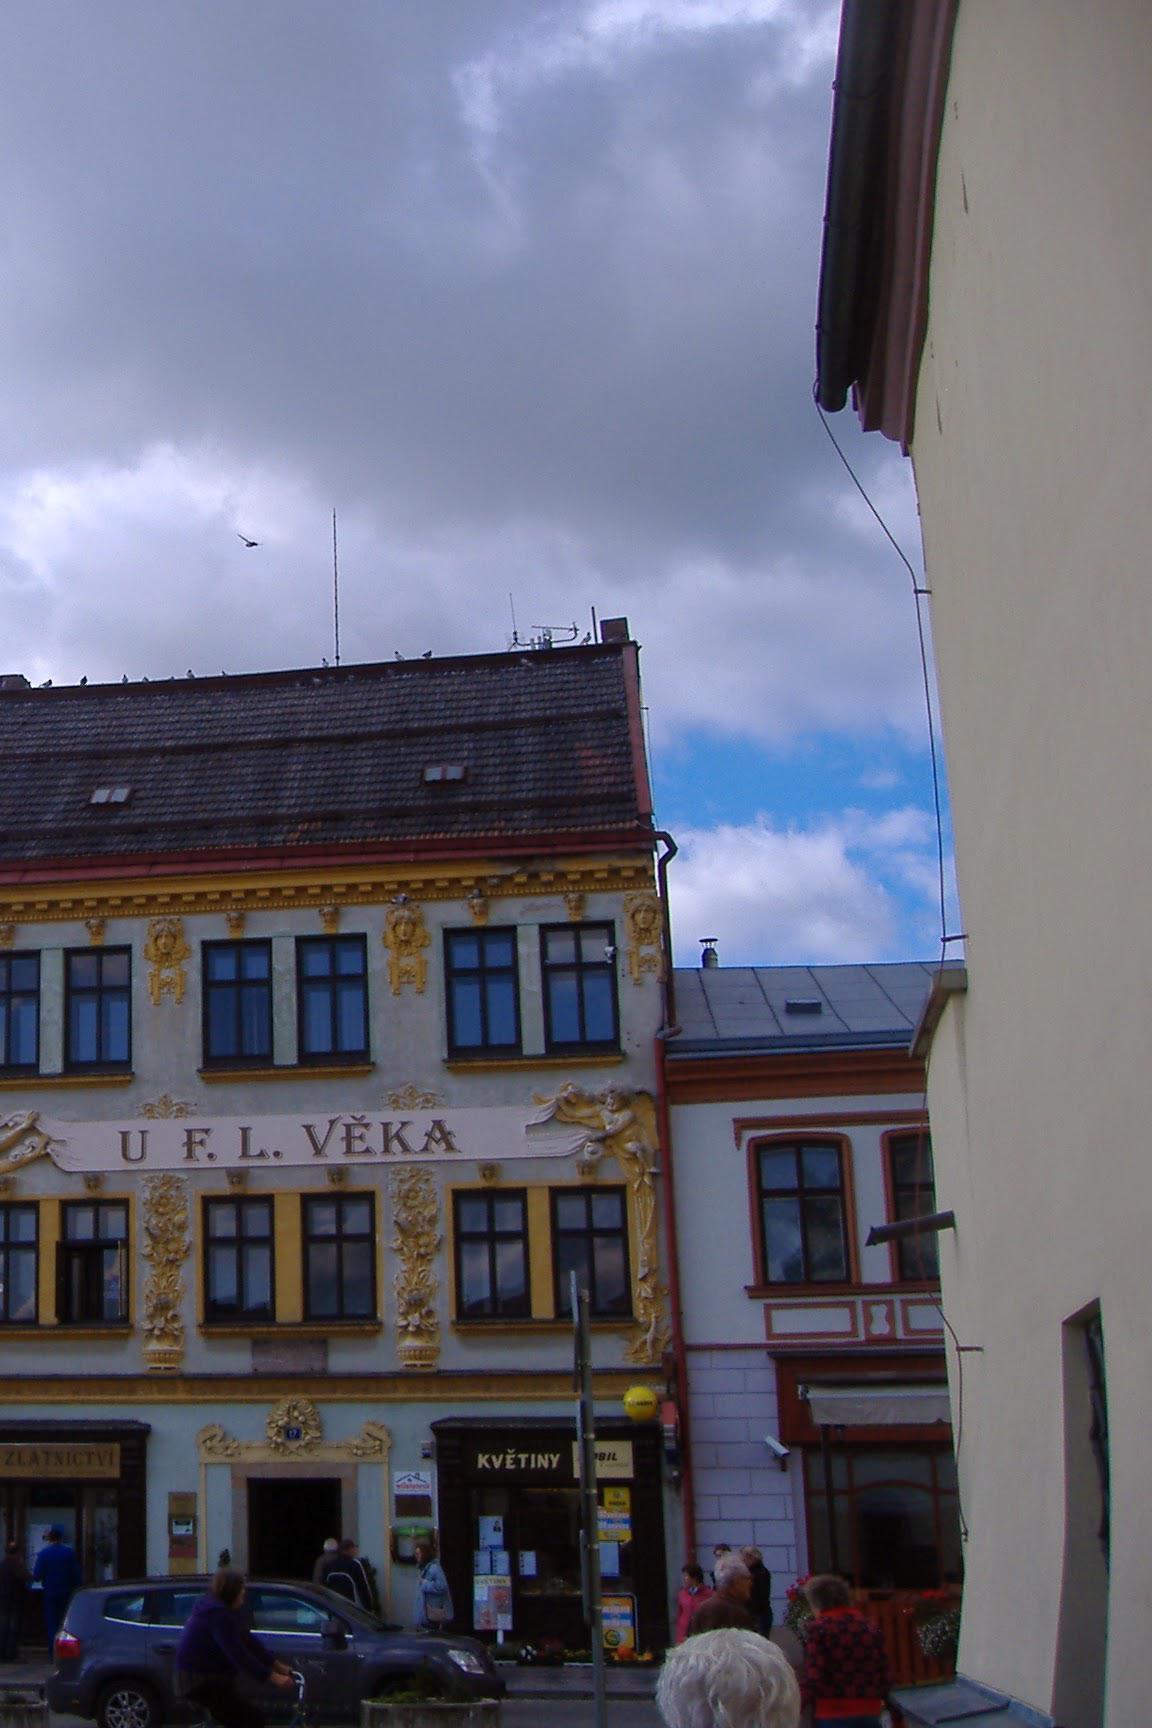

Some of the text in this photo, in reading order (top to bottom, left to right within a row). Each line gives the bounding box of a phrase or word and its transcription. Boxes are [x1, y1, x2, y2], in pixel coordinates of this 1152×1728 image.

[119, 1114, 462, 1164] U F. L. VĚKA
[477, 1448, 561, 1470] KVĚTINY
